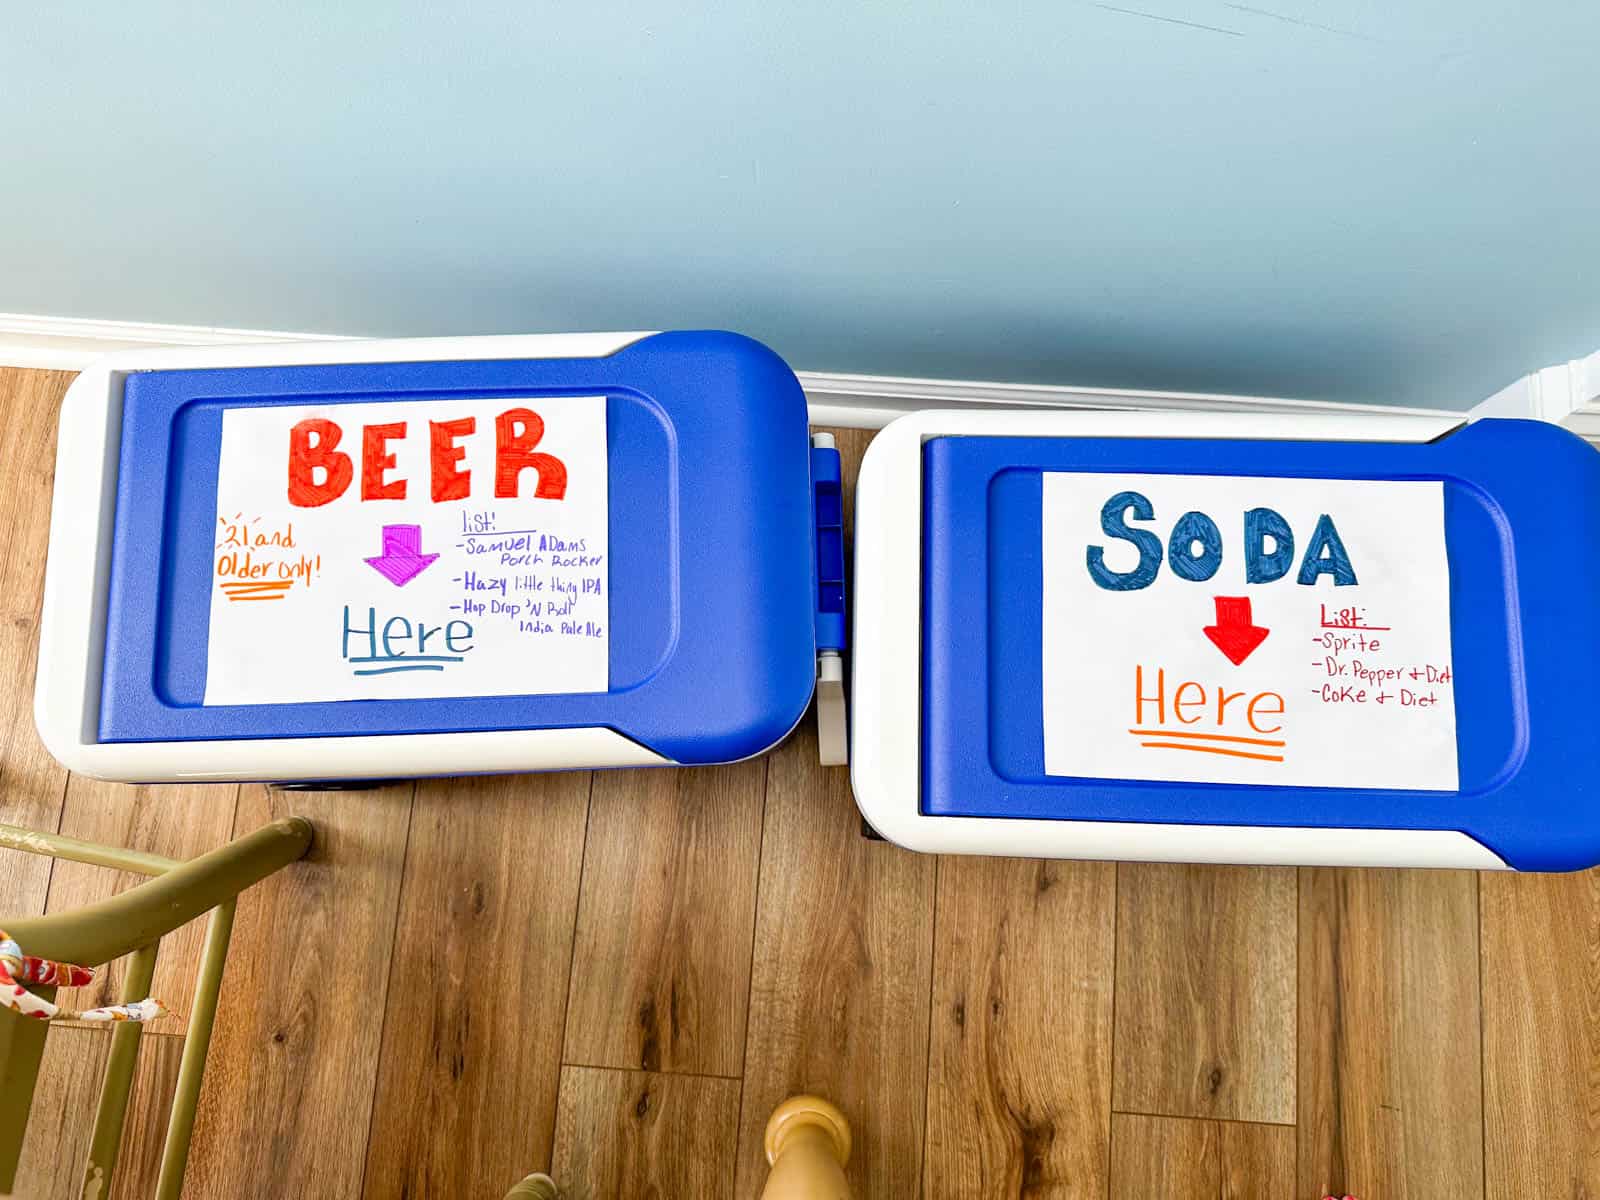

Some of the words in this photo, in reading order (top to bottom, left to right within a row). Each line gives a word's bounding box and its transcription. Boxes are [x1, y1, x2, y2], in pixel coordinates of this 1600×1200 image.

[288, 408, 567, 508] BEER
[225, 525, 248, 546] 21
[255, 523, 296, 548] and
[1086, 491, 1359, 591] SODA
[217, 552, 273, 579] Older
[278, 554, 321, 587] only!
[500, 553, 543, 566] Porch
[582, 578, 601, 595] IPA
[491, 599, 521, 619] Drop
[548, 601, 572, 616] Roll
[343, 605, 474, 657] Here
[520, 620, 553, 634] India
[561, 621, 582, 634] Pale
[586, 622, 602, 638] Ale
[1353, 659, 1403, 687] Pepper
[1135, 665, 1285, 733] Here
[1401, 688, 1438, 706] Diet
